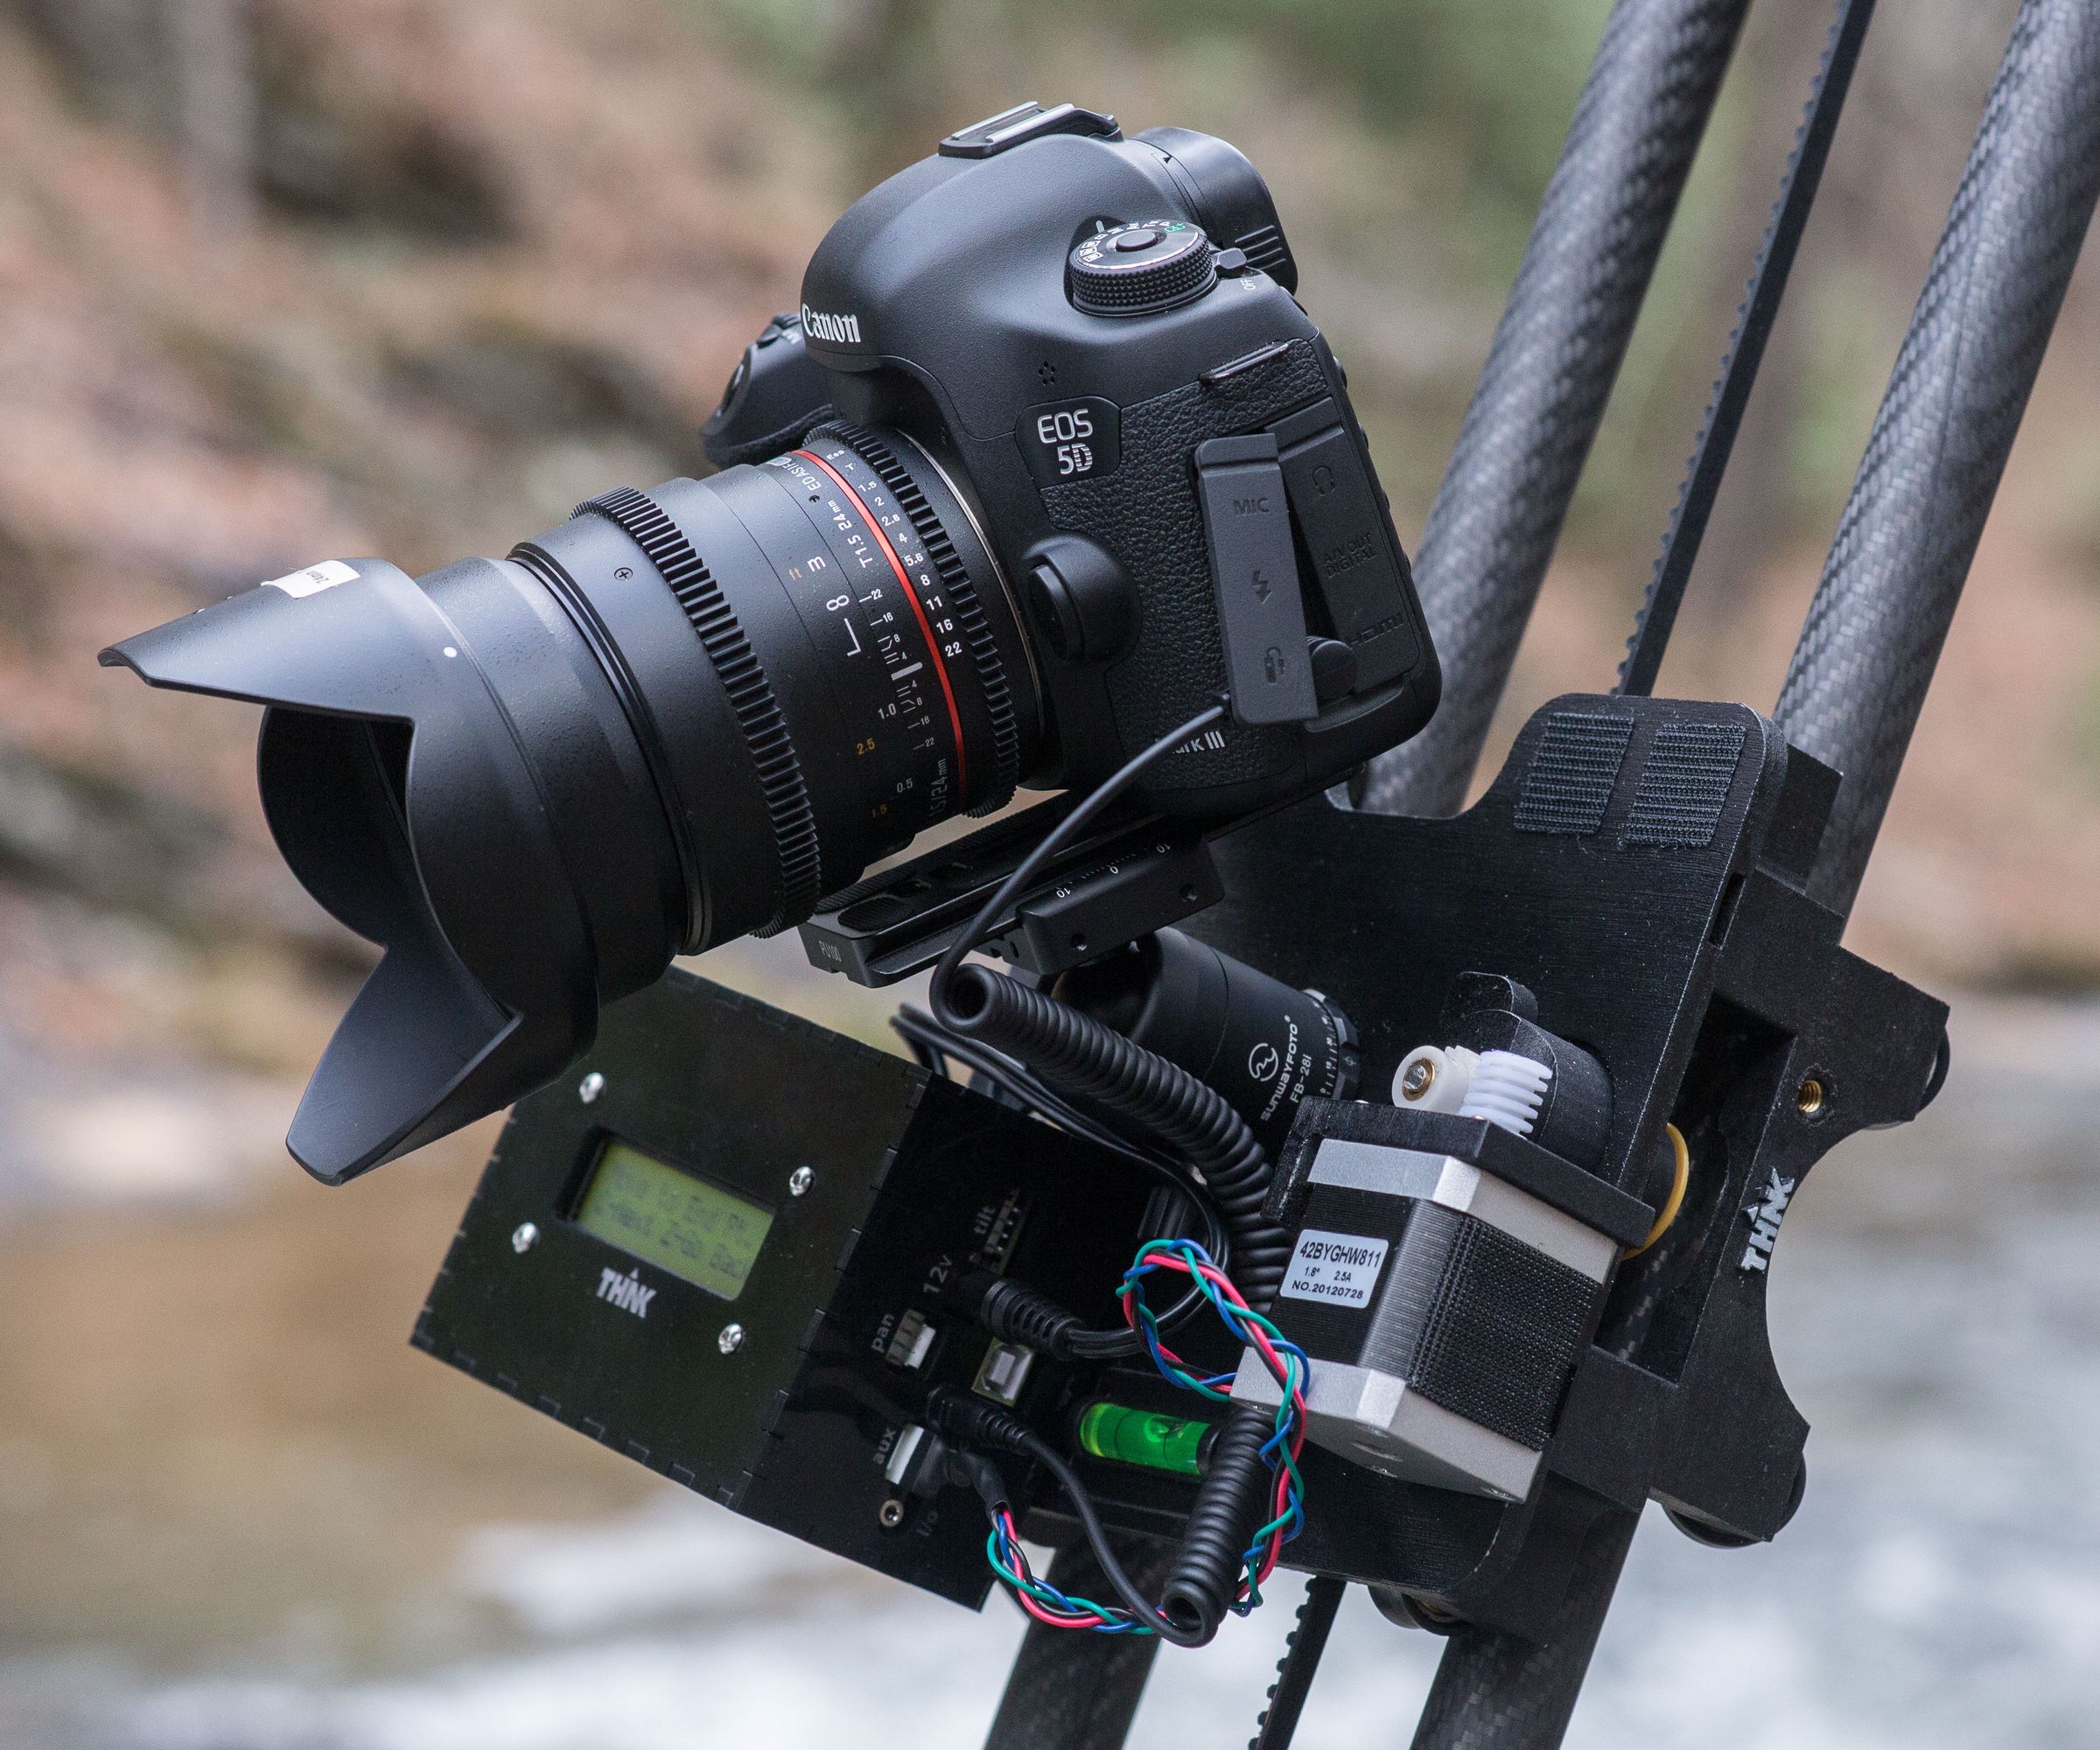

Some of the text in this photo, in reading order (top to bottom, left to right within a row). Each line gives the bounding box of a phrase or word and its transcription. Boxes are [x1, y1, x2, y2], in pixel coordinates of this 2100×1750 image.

[1240, 278, 1256, 290] OFF
[801, 303, 862, 344] Canon
[1036, 408, 1094, 444] EOS
[1056, 442, 1094, 475] 5D
[858, 480, 877, 493] 1.5
[875, 496, 885, 507] 2
[1232, 497, 1270, 516] MIC
[881, 513, 900, 527] 2.8
[898, 532, 908, 543] 4
[904, 552, 924, 567] 5.6
[920, 574, 930, 586] 8
[926, 595, 942, 611] 11
[936, 619, 953, 634] 16
[945, 641, 962, 657] 22
[878, 703, 897, 719] 1.0
[856, 738, 875, 755] 2.5
[1299, 1241, 1382, 1268] 42BYGHW811
[1334, 1270, 1352, 1282] 2.5A
[1292, 1280, 1364, 1299] NO.20120728
[871, 1313, 896, 1354] pan
[873, 1426, 898, 1466] aux
